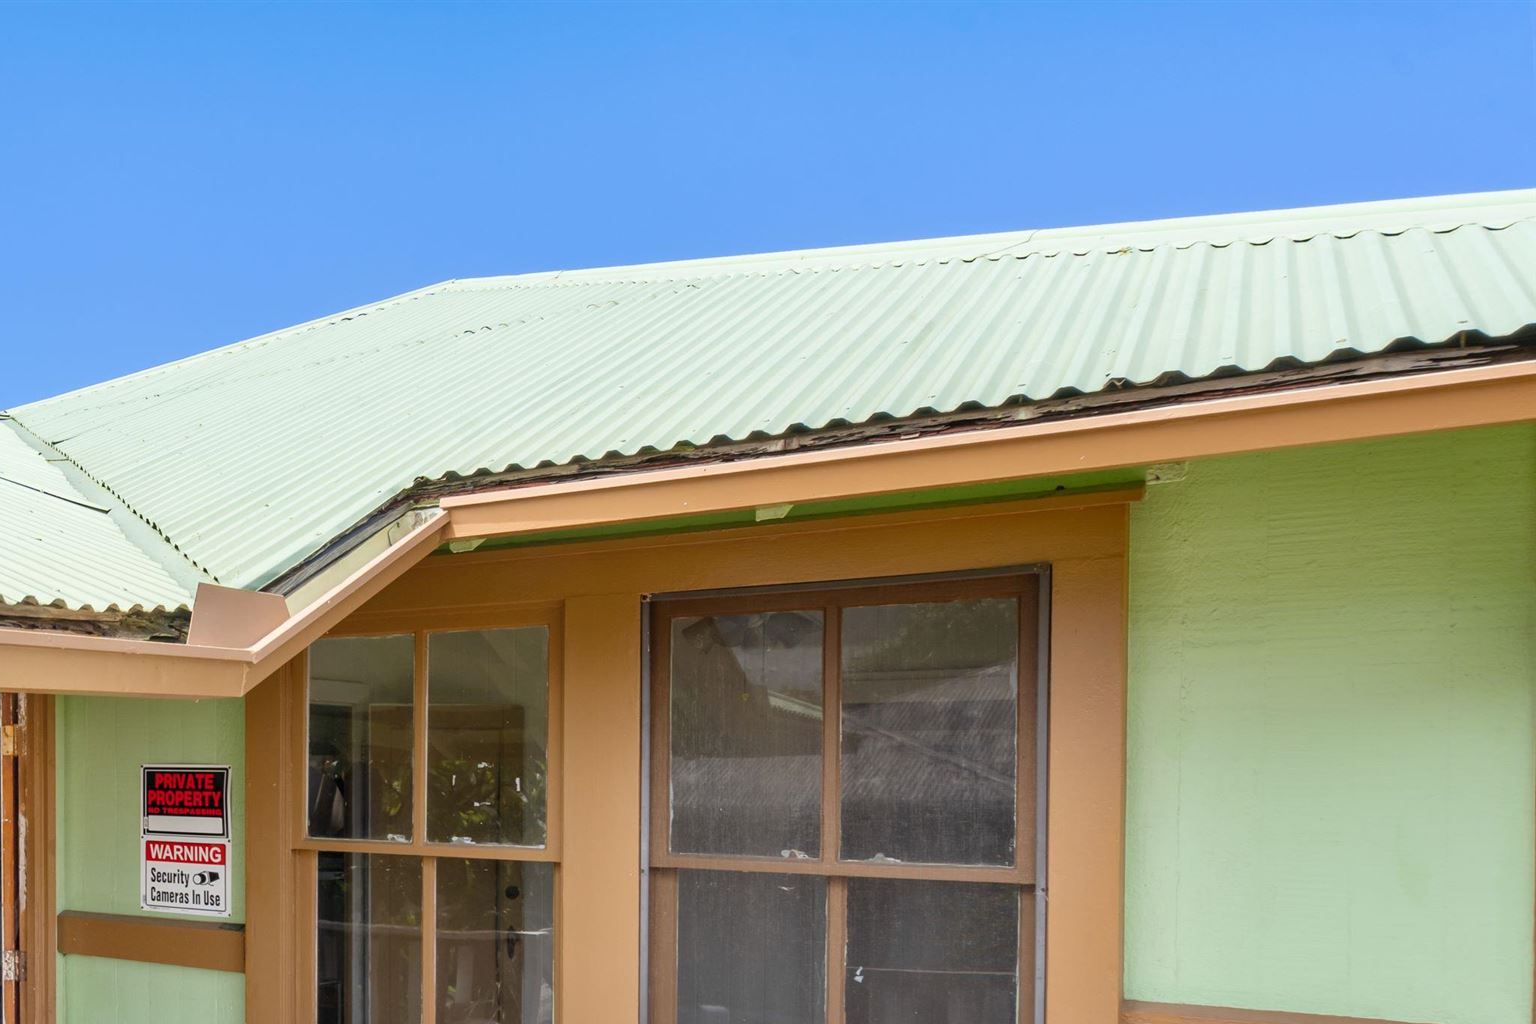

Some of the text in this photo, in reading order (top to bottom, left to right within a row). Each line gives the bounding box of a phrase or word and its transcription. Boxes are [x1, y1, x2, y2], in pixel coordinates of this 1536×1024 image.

[154, 773, 214, 789] PRIVATE
[147, 790, 221, 807] PROPERTY
[163, 807, 222, 816] TRESPASSING
[150, 843, 222, 863] WARNING
[150, 867, 190, 888] Security
[150, 886, 221, 906] Cameras In Use
